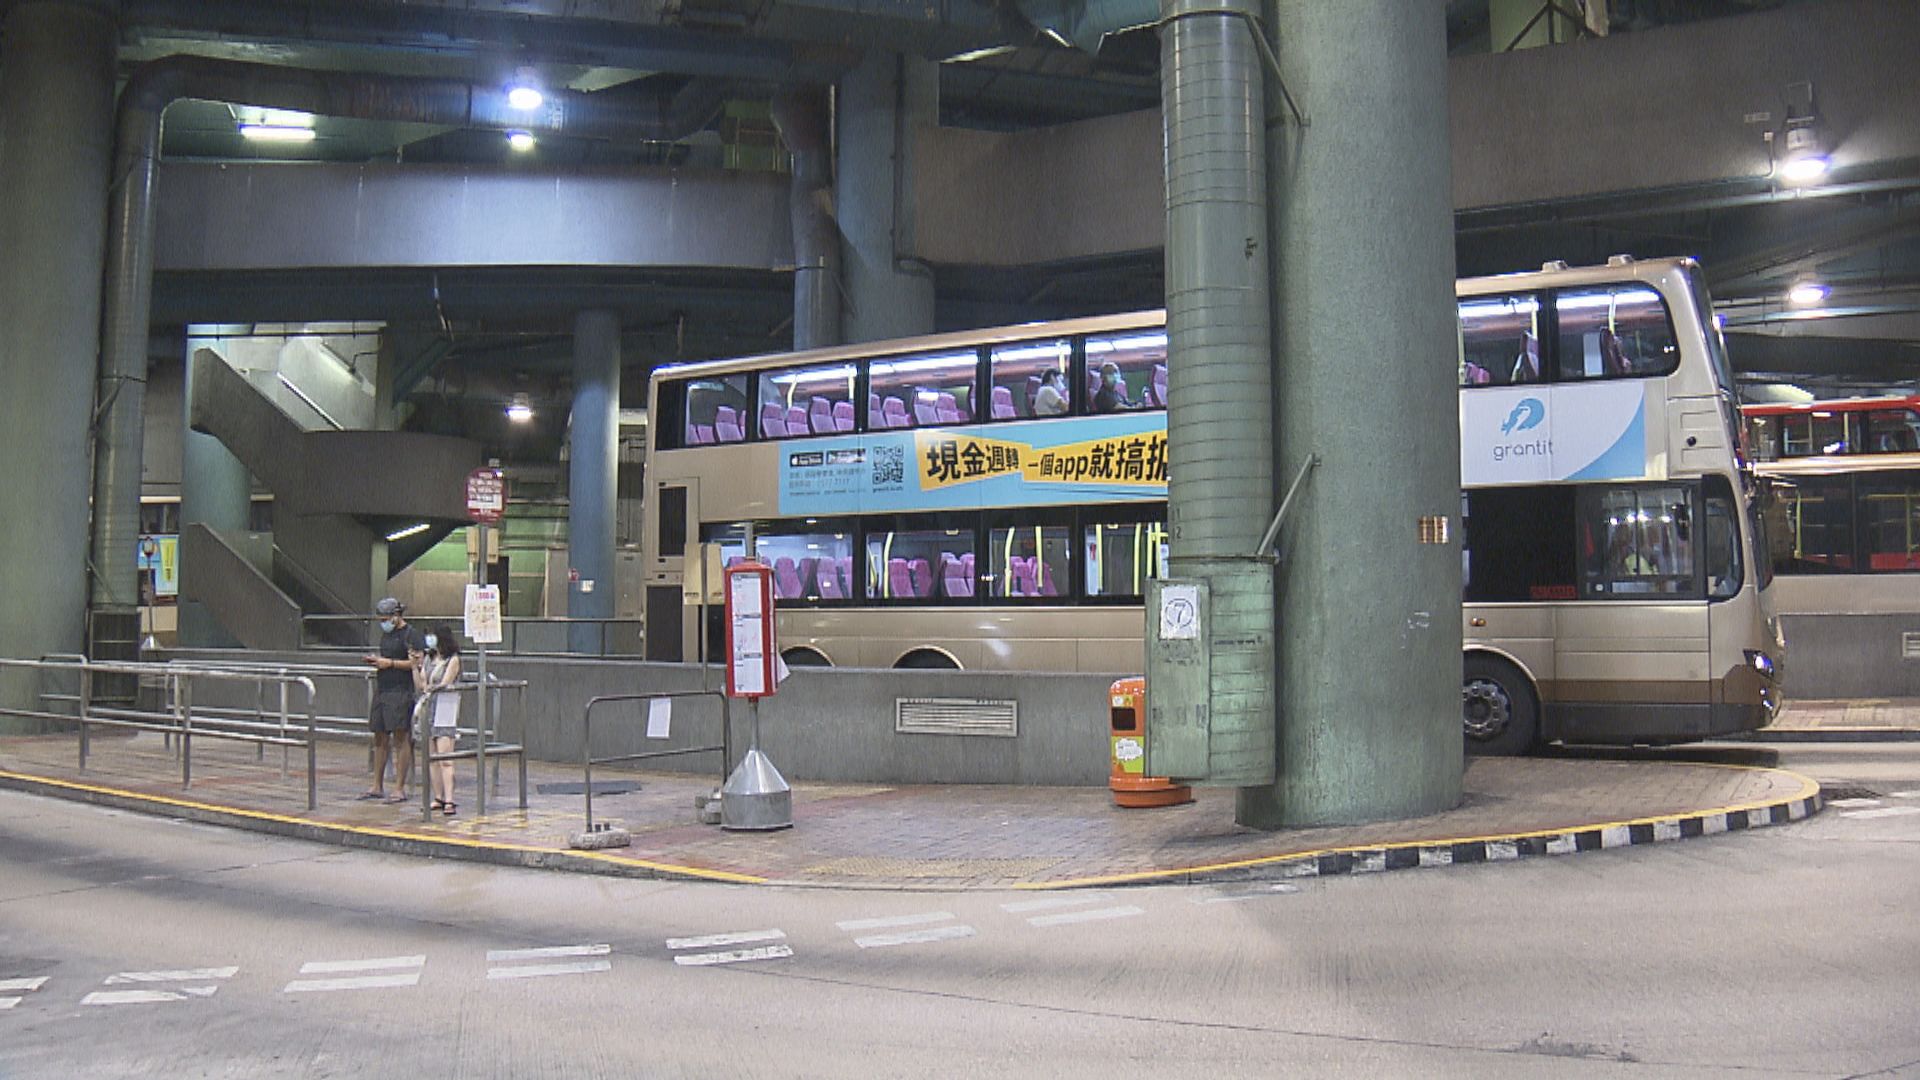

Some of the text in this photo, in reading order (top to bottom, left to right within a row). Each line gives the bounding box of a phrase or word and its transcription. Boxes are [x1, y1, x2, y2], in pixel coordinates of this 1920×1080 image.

[926, 440, 1020, 482] 現金週轉
[1493, 438, 1554, 461] grantit
[1174, 602, 1187, 623] 7
